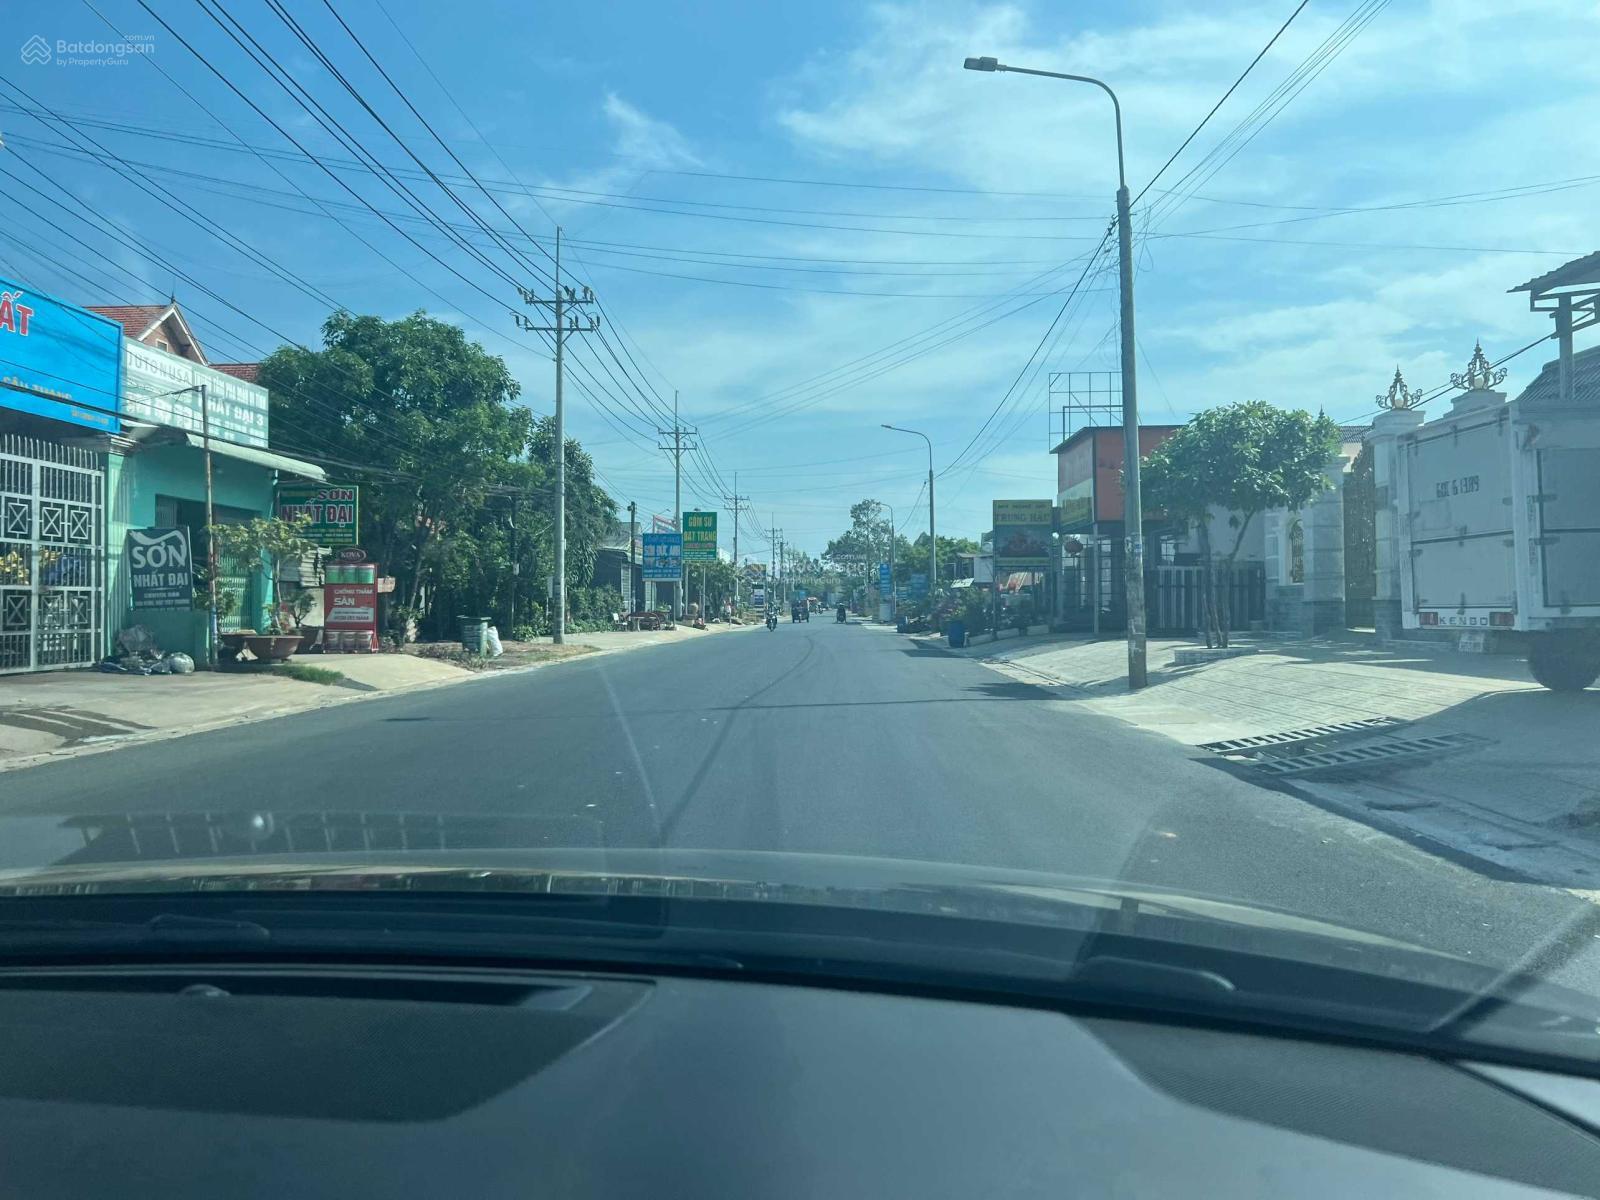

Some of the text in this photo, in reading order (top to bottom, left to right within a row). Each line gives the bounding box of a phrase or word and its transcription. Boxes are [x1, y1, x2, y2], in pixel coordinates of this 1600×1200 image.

[257, 413, 263, 426] 3
[318, 488, 354, 501] SƠN
[326, 504, 354, 527] ĐẠI
[132, 541, 187, 568] SƠN
[133, 569, 189, 588] NHẤT ĐẠI
[1439, 616, 1489, 626] KENBO
